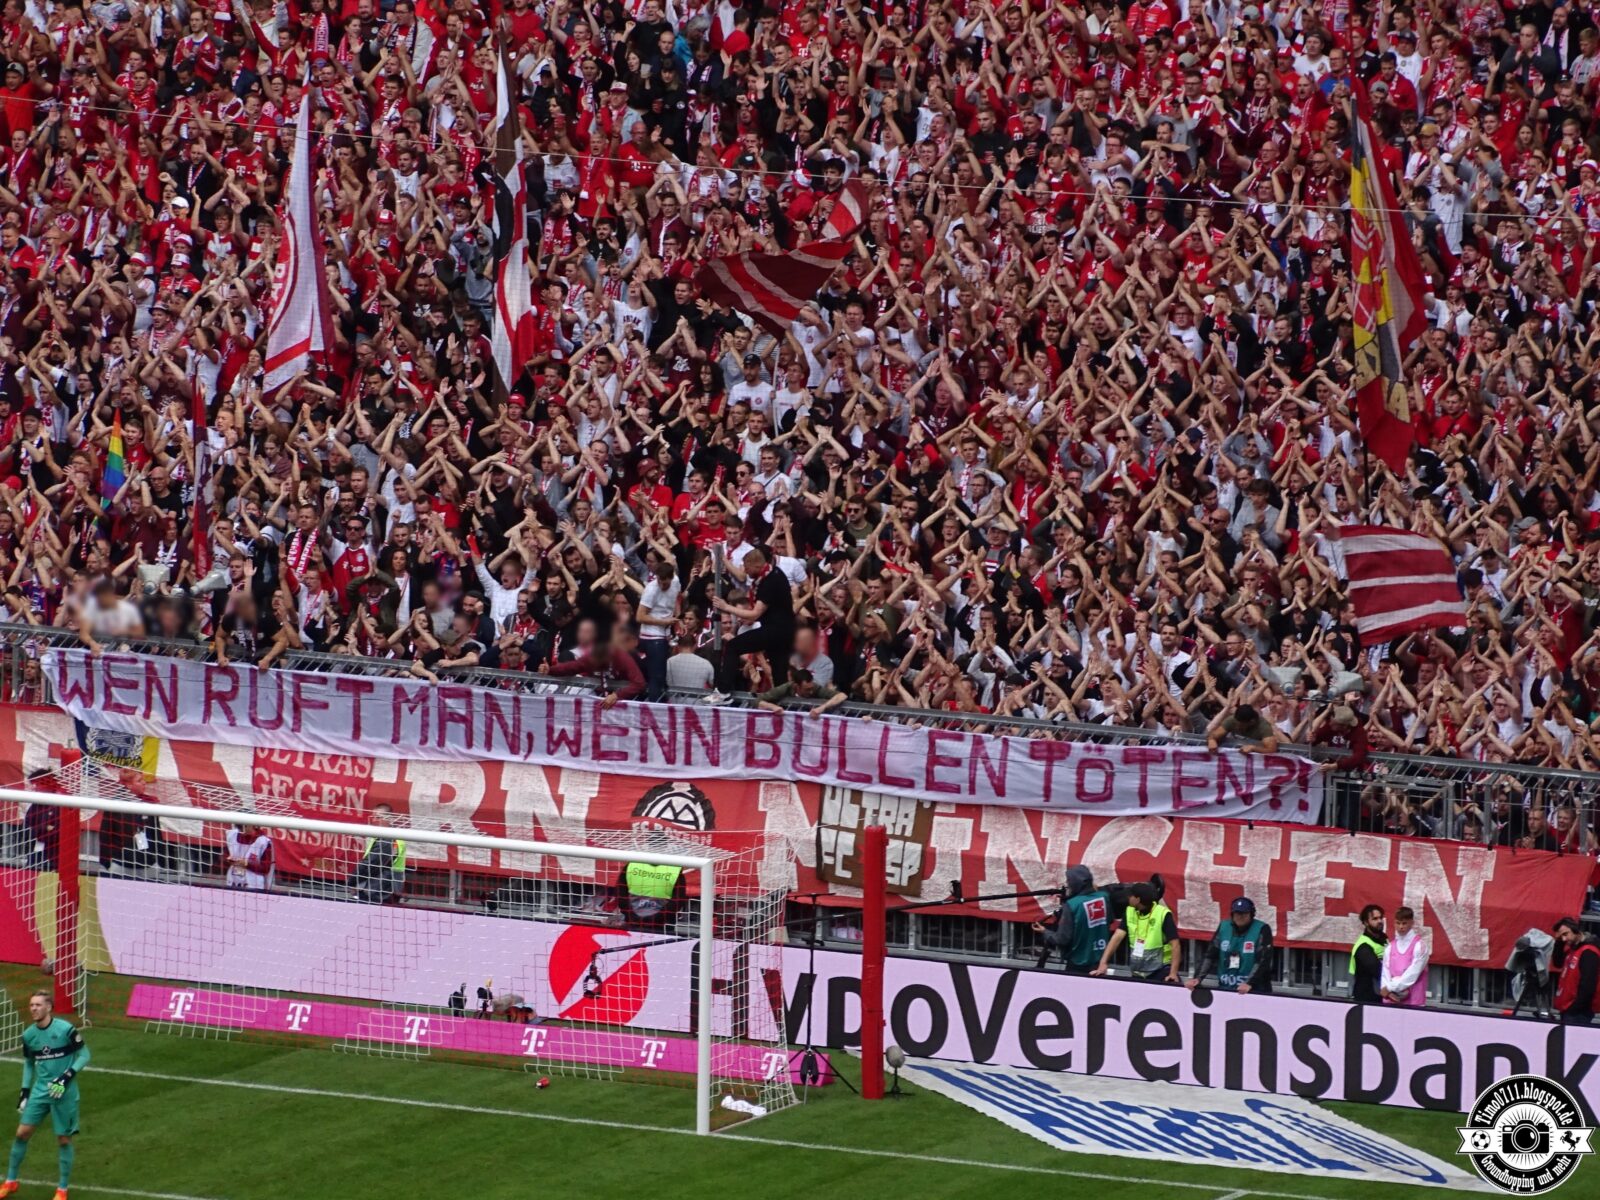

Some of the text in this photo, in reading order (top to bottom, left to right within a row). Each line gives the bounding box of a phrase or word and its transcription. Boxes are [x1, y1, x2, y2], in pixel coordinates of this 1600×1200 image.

[57, 651, 178, 723] WEN
[202, 666, 373, 741] RUFT
[391, 685, 534, 760] MAN,
[546, 696, 720, 768] WENN
[744, 710, 1008, 798] BULLEN
[253, 766, 368, 818] GEGEN
[632, 867, 673, 881] Steward
[690, 936, 1600, 1127] HypoVereinsbank
